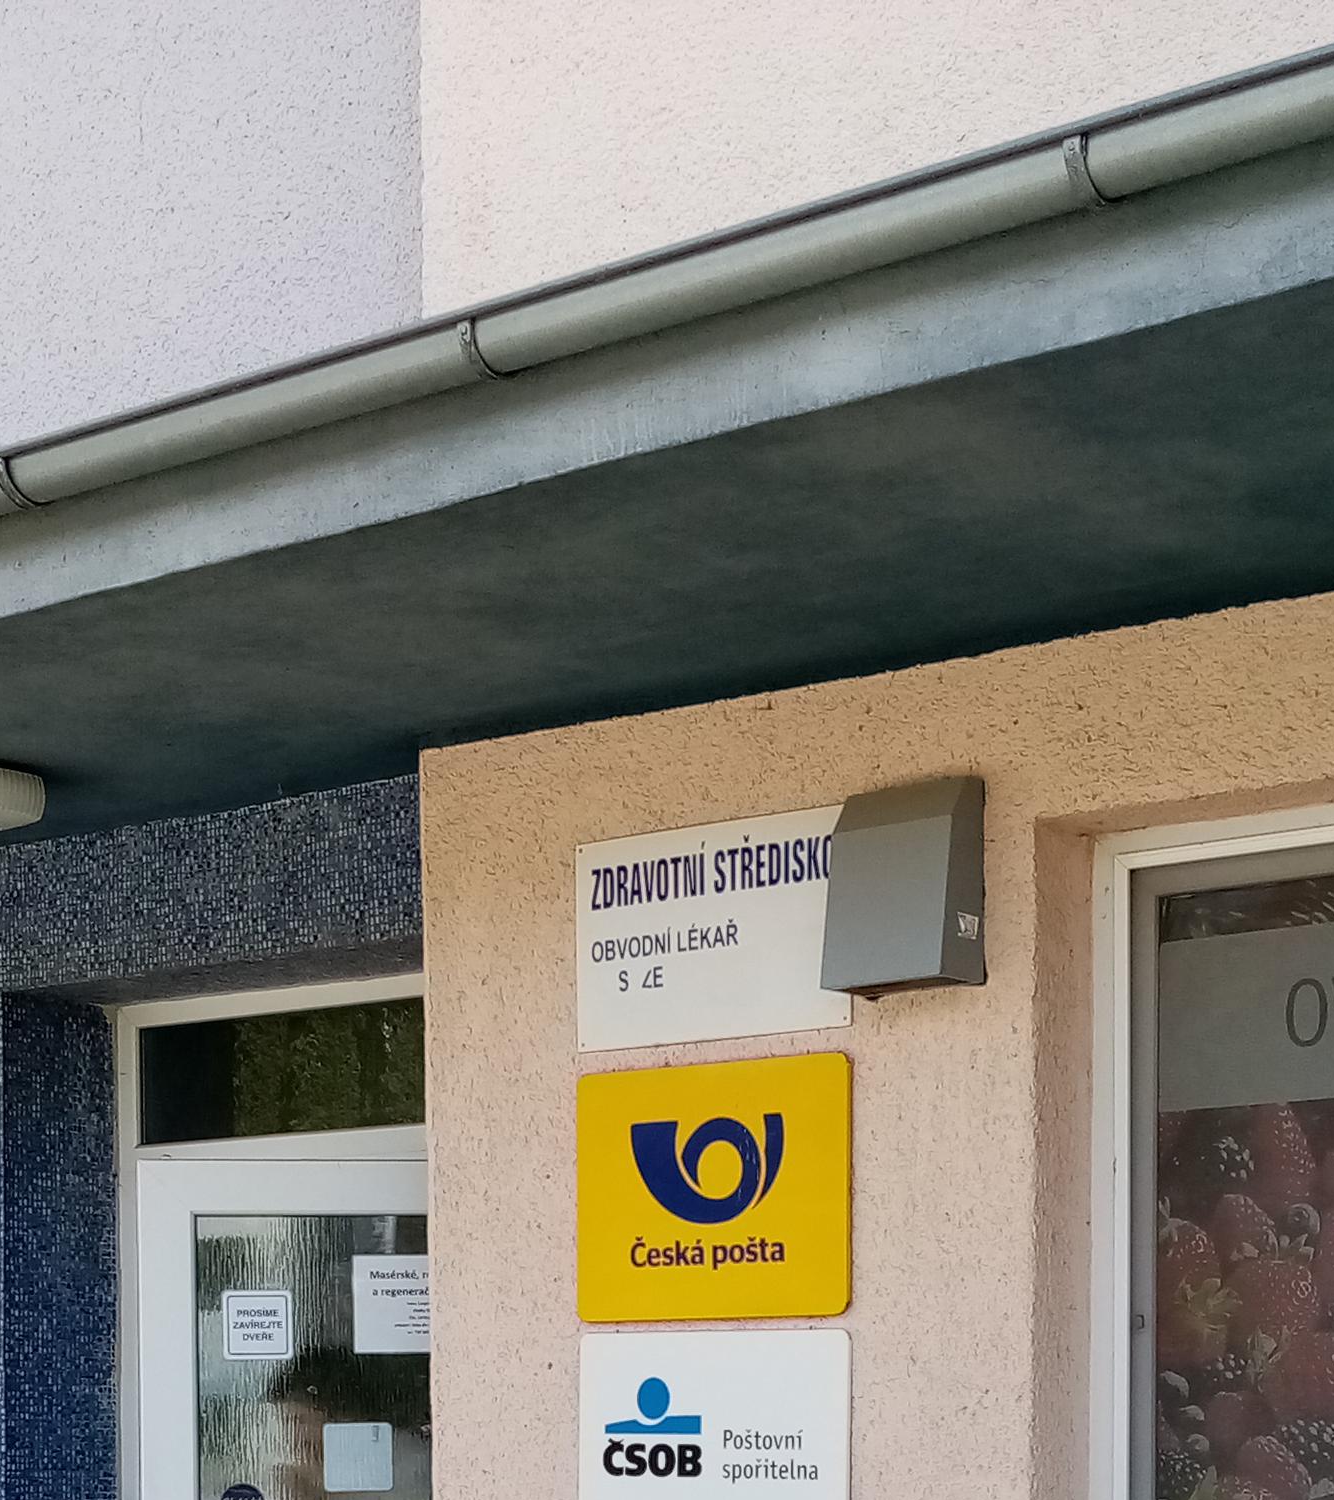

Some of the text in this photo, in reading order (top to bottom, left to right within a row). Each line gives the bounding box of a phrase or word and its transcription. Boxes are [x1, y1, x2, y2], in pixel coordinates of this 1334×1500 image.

[591, 834, 833, 911] ZDRAVOTNÍ STŘEDISKO
[591, 918, 740, 963] OBVODNÍ LÉKAŘ
[630, 1236, 786, 1271] Česká pošta
[236, 1306, 280, 1318] PROSÍME
[242, 1332, 275, 1342] DVEŘE
[722, 1429, 803, 1453] Poštovní
[602, 1438, 703, 1478] ČSOB
[722, 1458, 820, 1484] spořitelna
